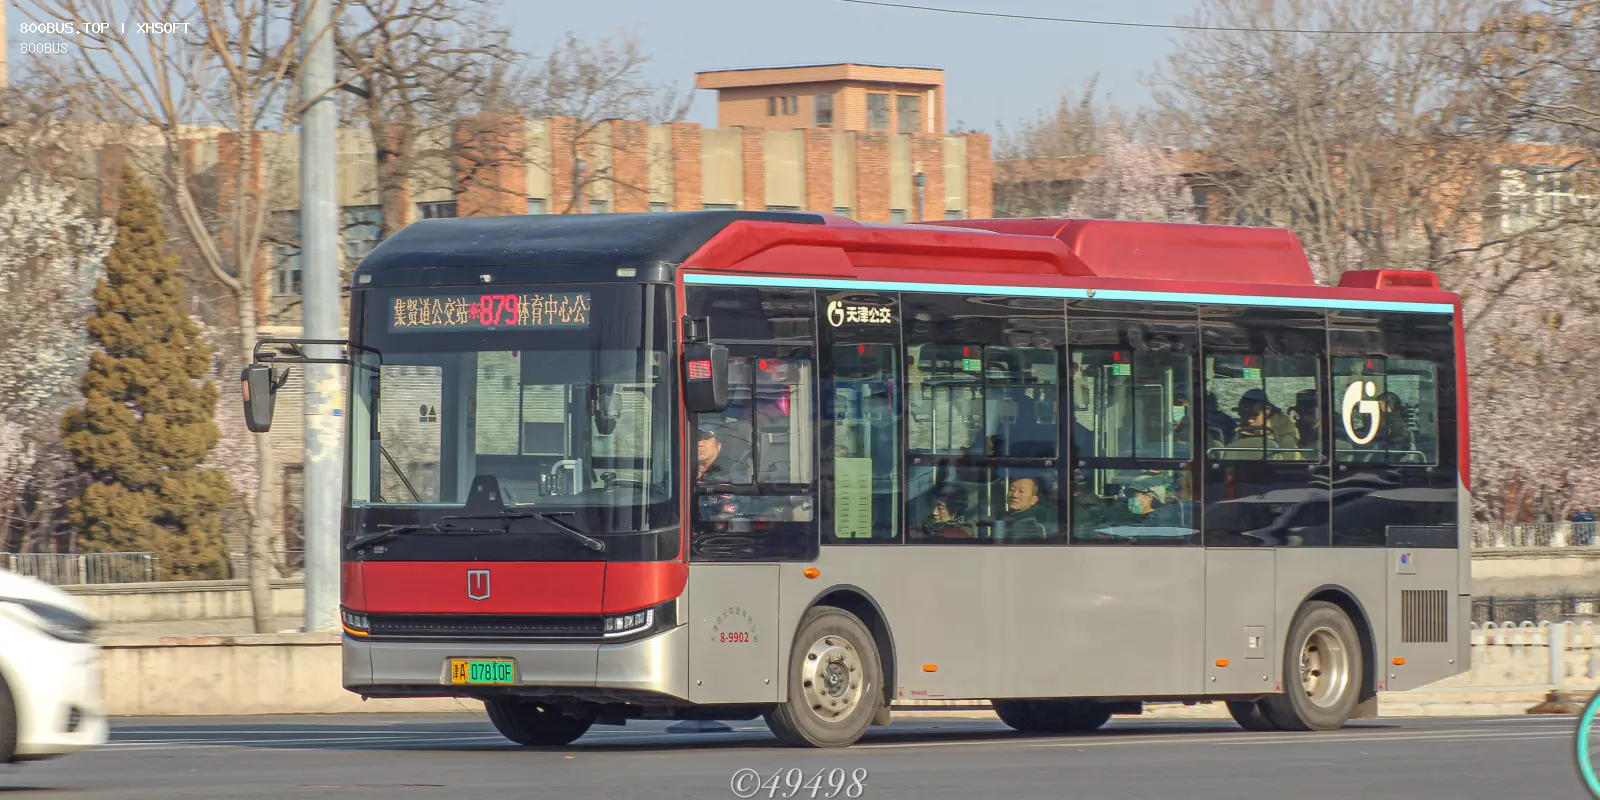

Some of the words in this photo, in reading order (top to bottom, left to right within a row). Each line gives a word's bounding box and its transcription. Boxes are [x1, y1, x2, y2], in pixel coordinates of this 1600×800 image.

[394, 297, 469, 326] 集贤道公交站
[479, 294, 519, 326] 879
[517, 293, 591, 326] 体育中心公
[846, 306, 892, 324] 天津公交
[720, 632, 749, 643] 8-9902
